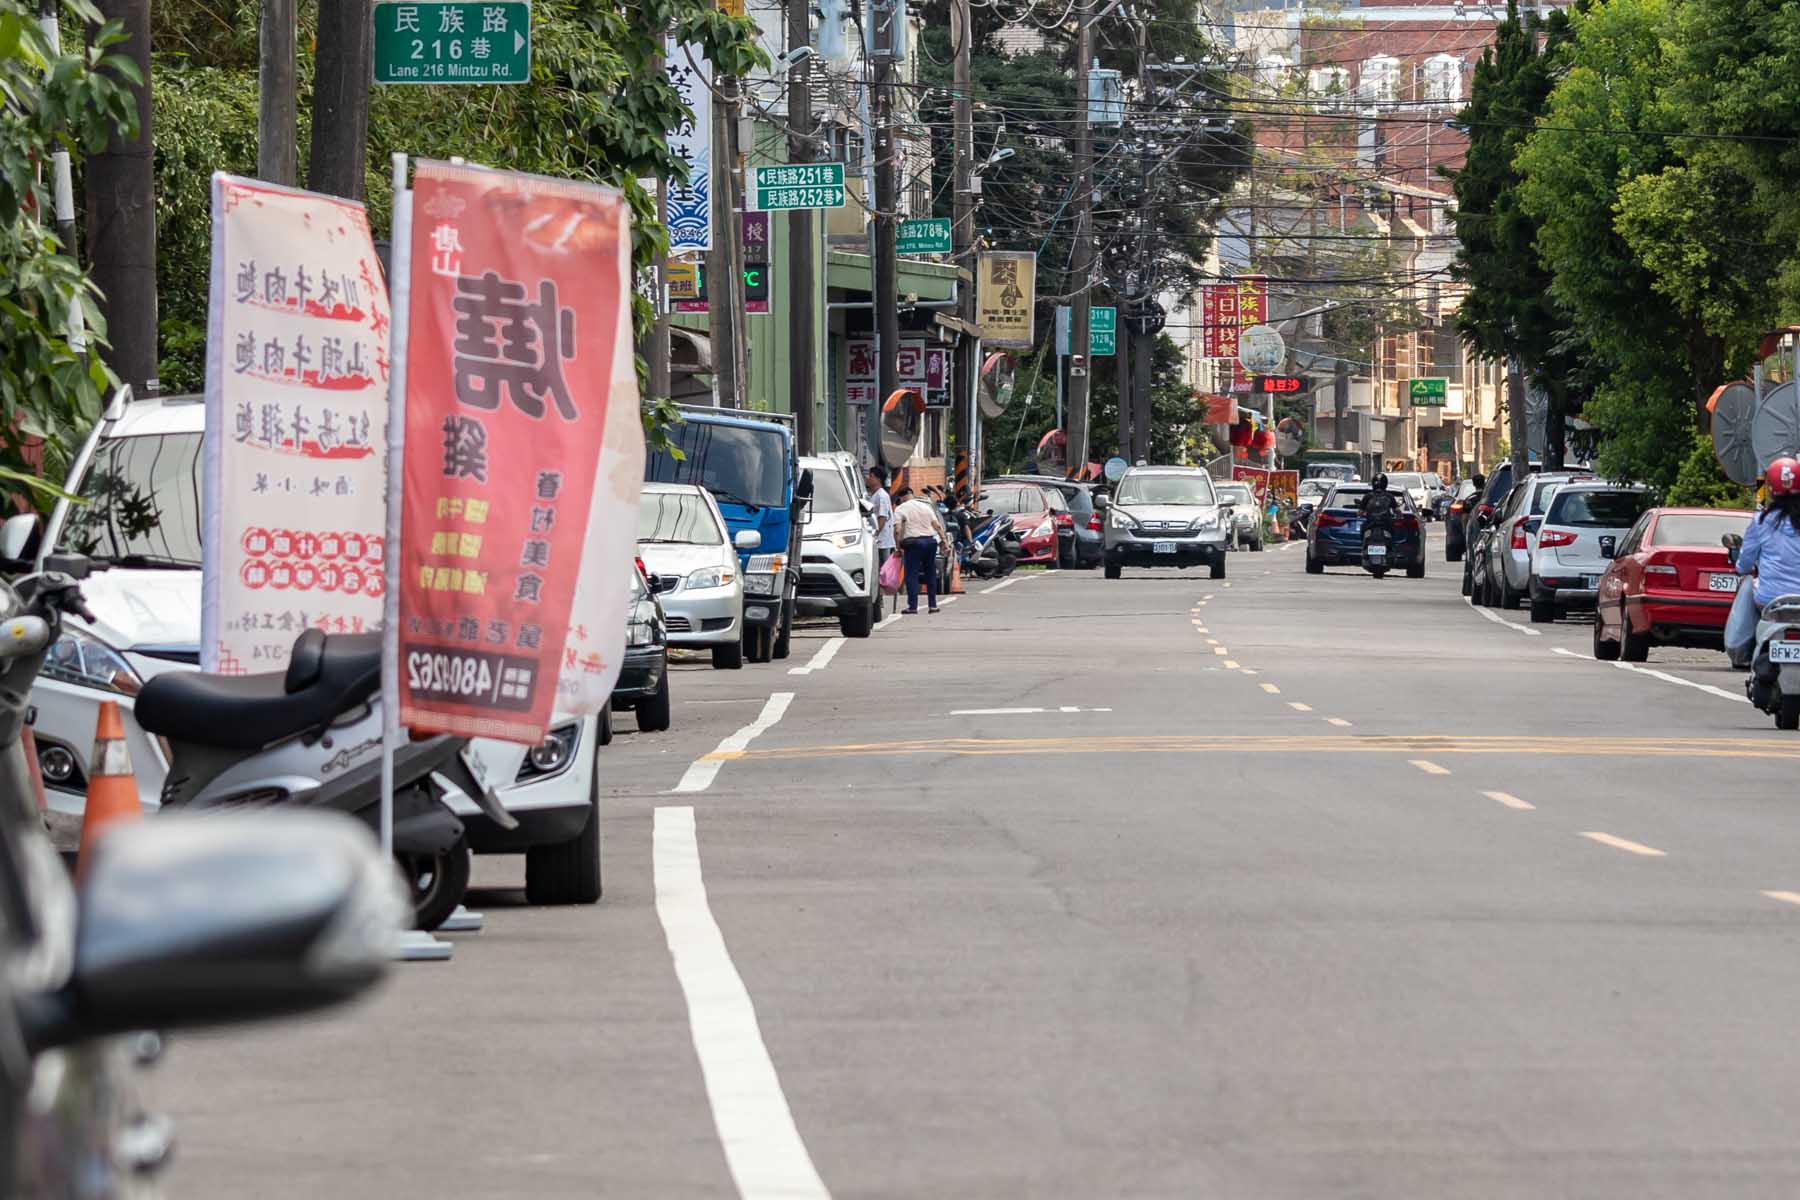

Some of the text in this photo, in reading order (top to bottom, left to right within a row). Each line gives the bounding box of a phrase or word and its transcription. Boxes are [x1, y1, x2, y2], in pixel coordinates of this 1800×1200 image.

[395, 7, 509, 33] 民族路
[389, 63, 513, 77] Lane 216 Mintzu Rd.
[766, 169, 834, 185] 民族路251巷
[768, 188, 834, 206] 民族路252巷
